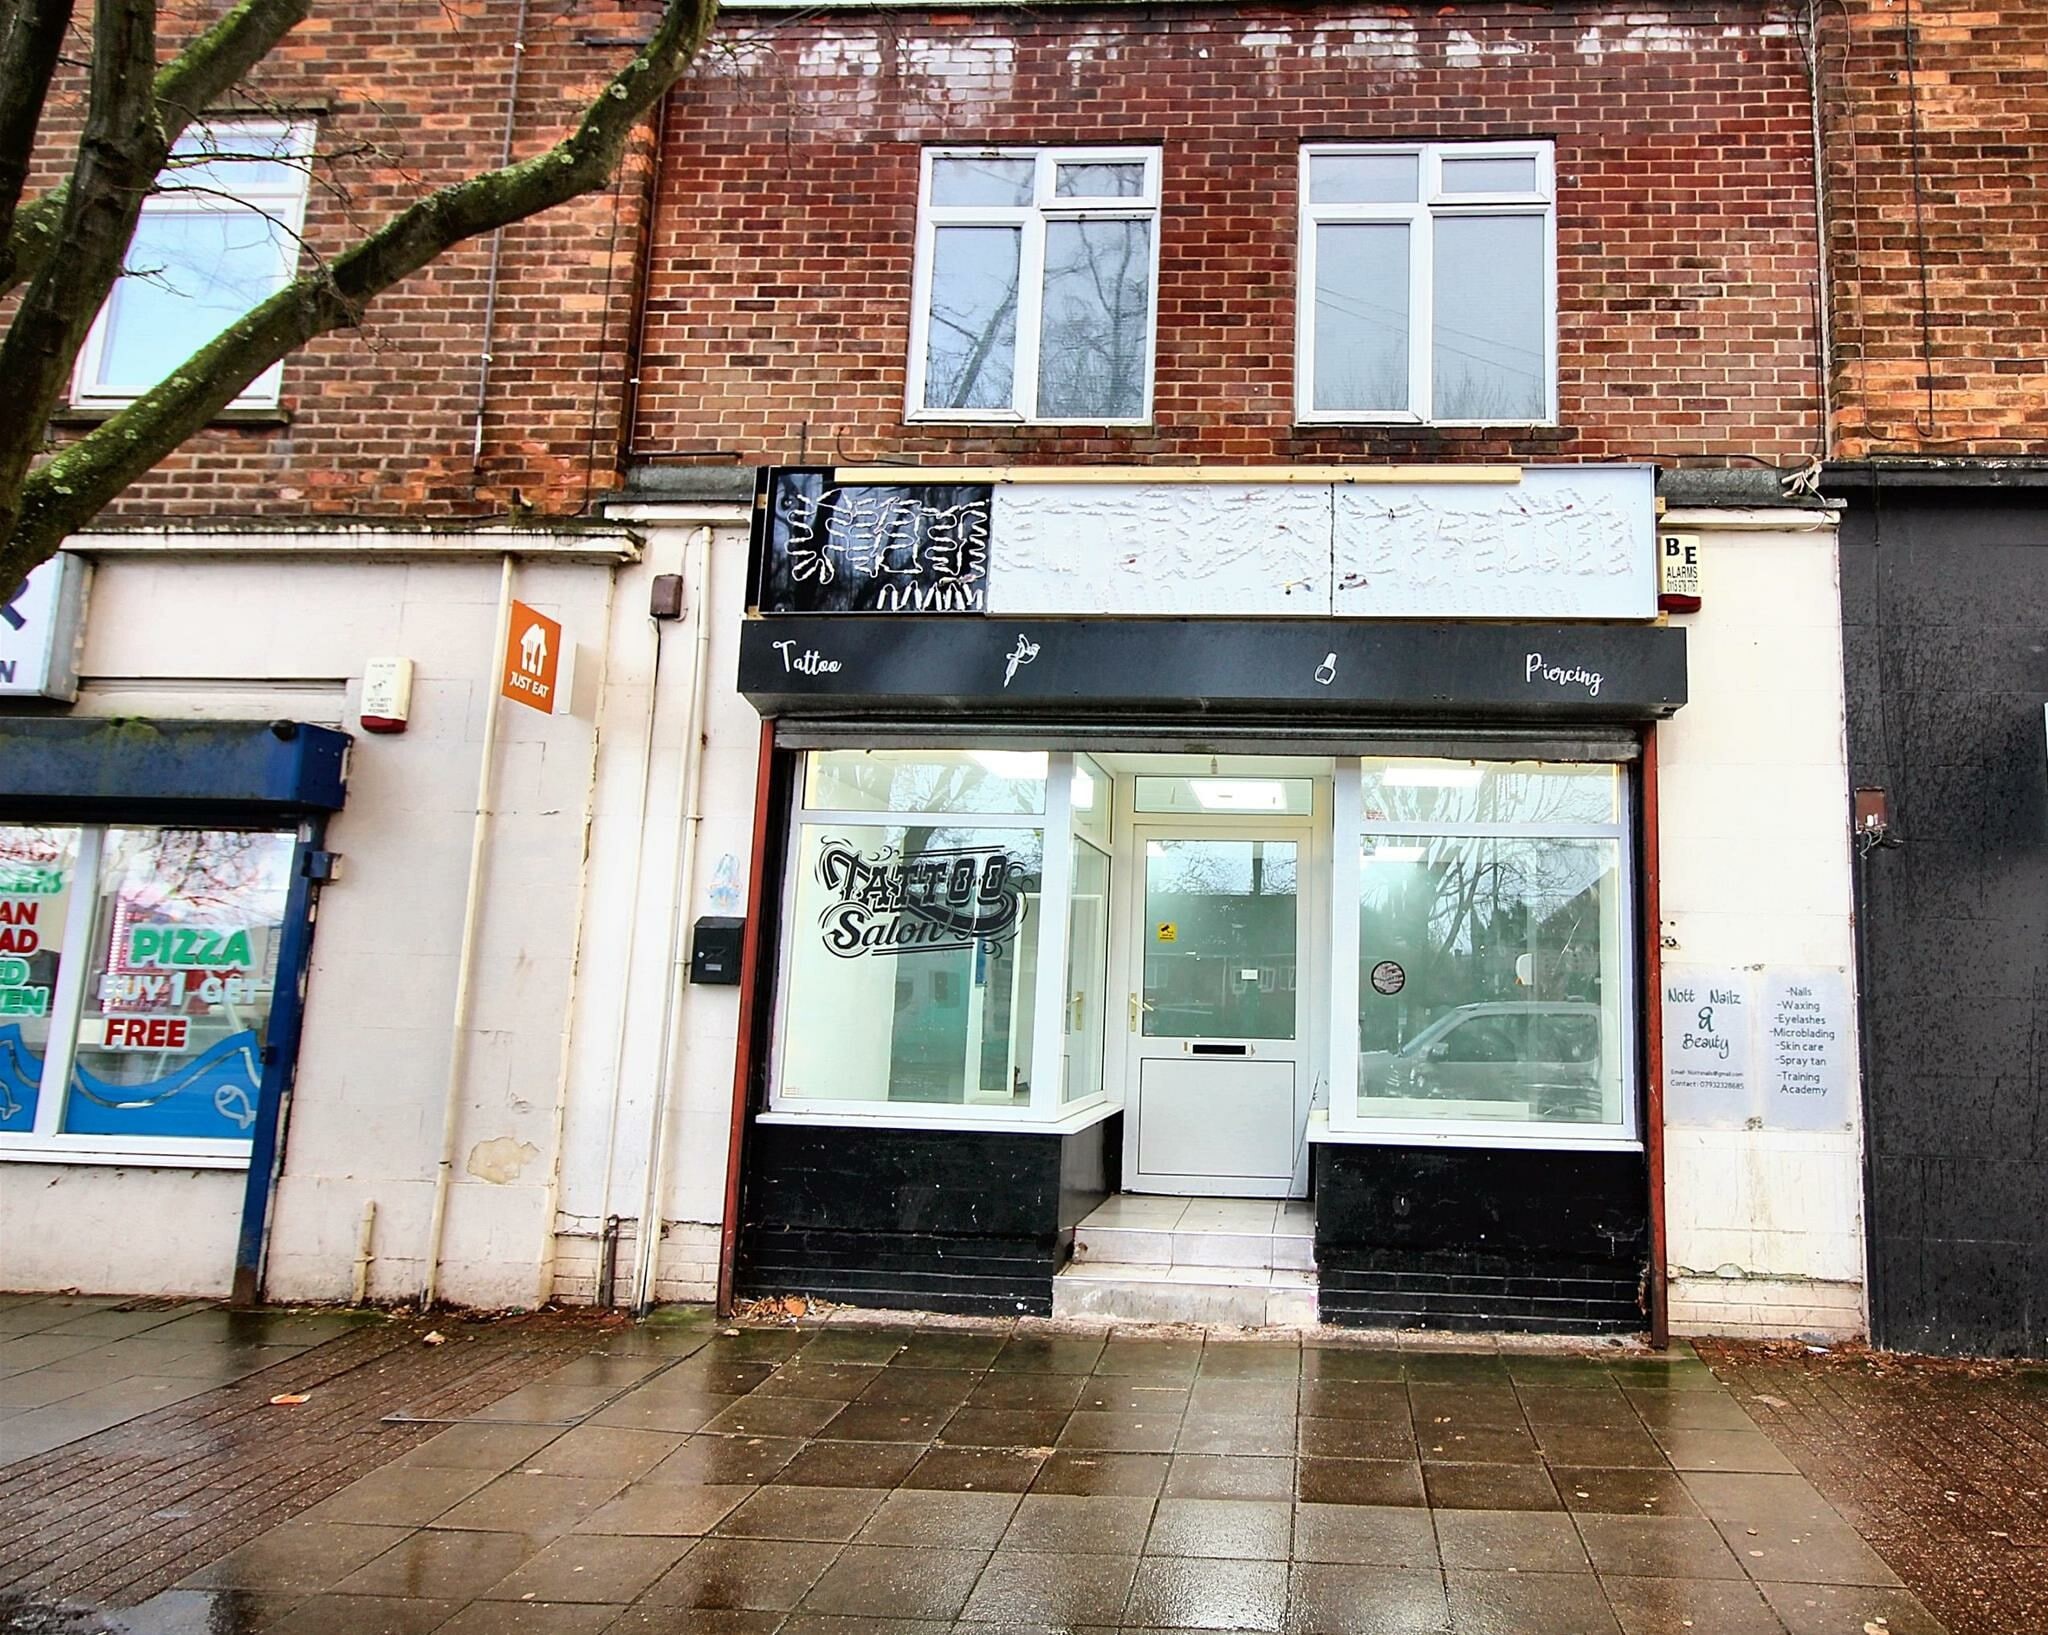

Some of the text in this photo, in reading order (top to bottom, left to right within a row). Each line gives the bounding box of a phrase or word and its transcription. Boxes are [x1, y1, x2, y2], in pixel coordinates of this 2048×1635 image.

[1665, 537, 1698, 565] B E
[1666, 566, 1698, 578] ALARMS
[772, 639, 843, 675] Tattoo
[509, 671, 550, 699] JUST EAT
[1525, 652, 1604, 696] Piercing
[821, 848, 1009, 913] TATTOO
[830, 907, 946, 951] Salon
[129, 926, 252, 967] PIZZA
[97, 974, 165, 1002] BUY
[199, 973, 262, 1006] GET
[1667, 987, 1742, 1005] Nott Nailz
[104, 1018, 187, 1048] FREE
[1682, 1032, 1730, 1060] Beauty
[1802, 1043, 1825, 1052] care
[1811, 1057, 1827, 1066] tan
[1779, 1084, 1828, 1097] Academy
